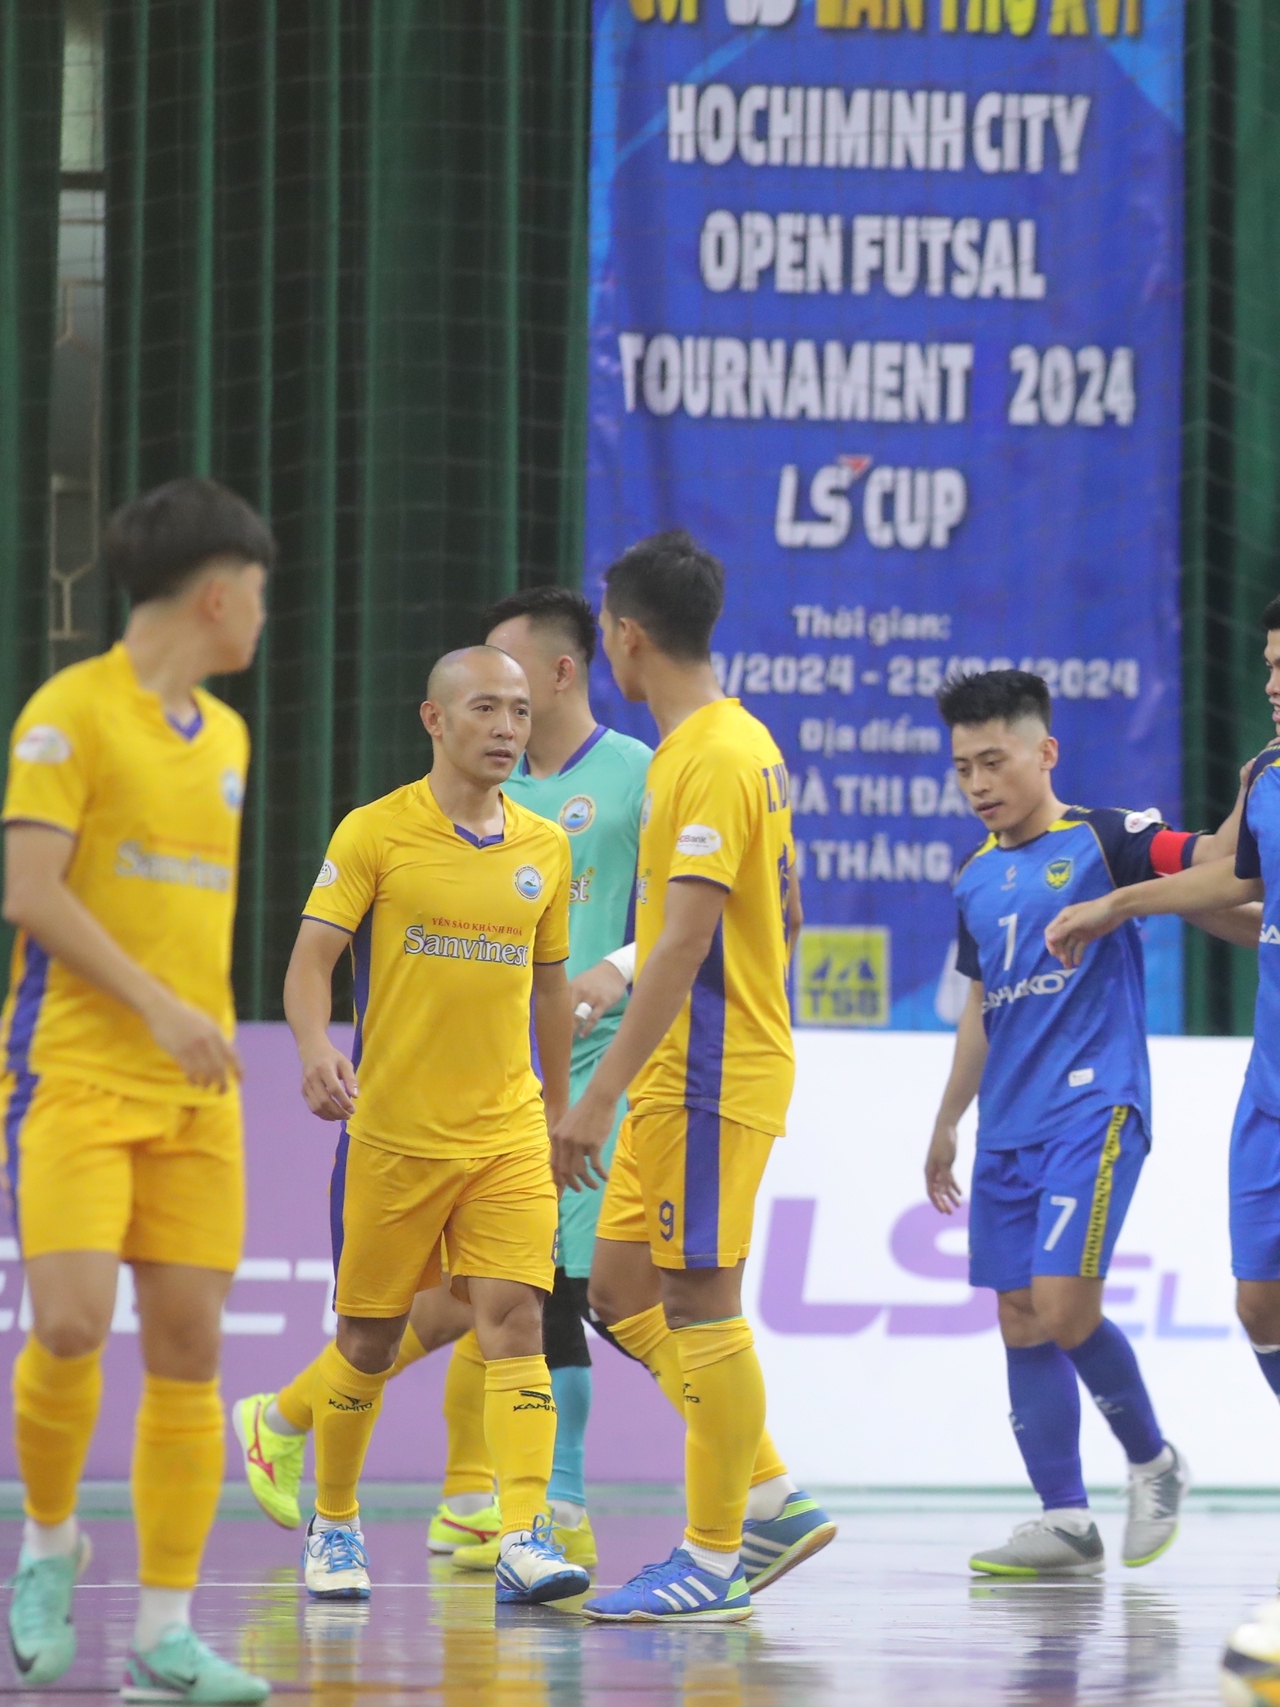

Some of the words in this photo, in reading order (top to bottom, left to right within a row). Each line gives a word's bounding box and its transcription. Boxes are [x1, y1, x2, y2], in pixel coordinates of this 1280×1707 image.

[666, 83, 966, 170] HOCHIMINH
[972, 92, 1091, 174] CITY
[700, 210, 843, 294] OPEN
[852, 215, 1046, 299] FUTSAL
[618, 333, 974, 423] TOURNAMENT
[1009, 345, 1135, 426] 2024
[775, 463, 852, 548] LS
[863, 466, 967, 550] CUP
[833, 775, 904, 816] THI
[404, 924, 529, 967] Sanvinest
[472, 922, 504, 934] KHÁNH
[998, 913, 1018, 971] 7
[658, 1200, 675, 1242] 9
[1043, 1196, 1077, 1251] 7
[328, 1399, 373, 1412] KAMITO
